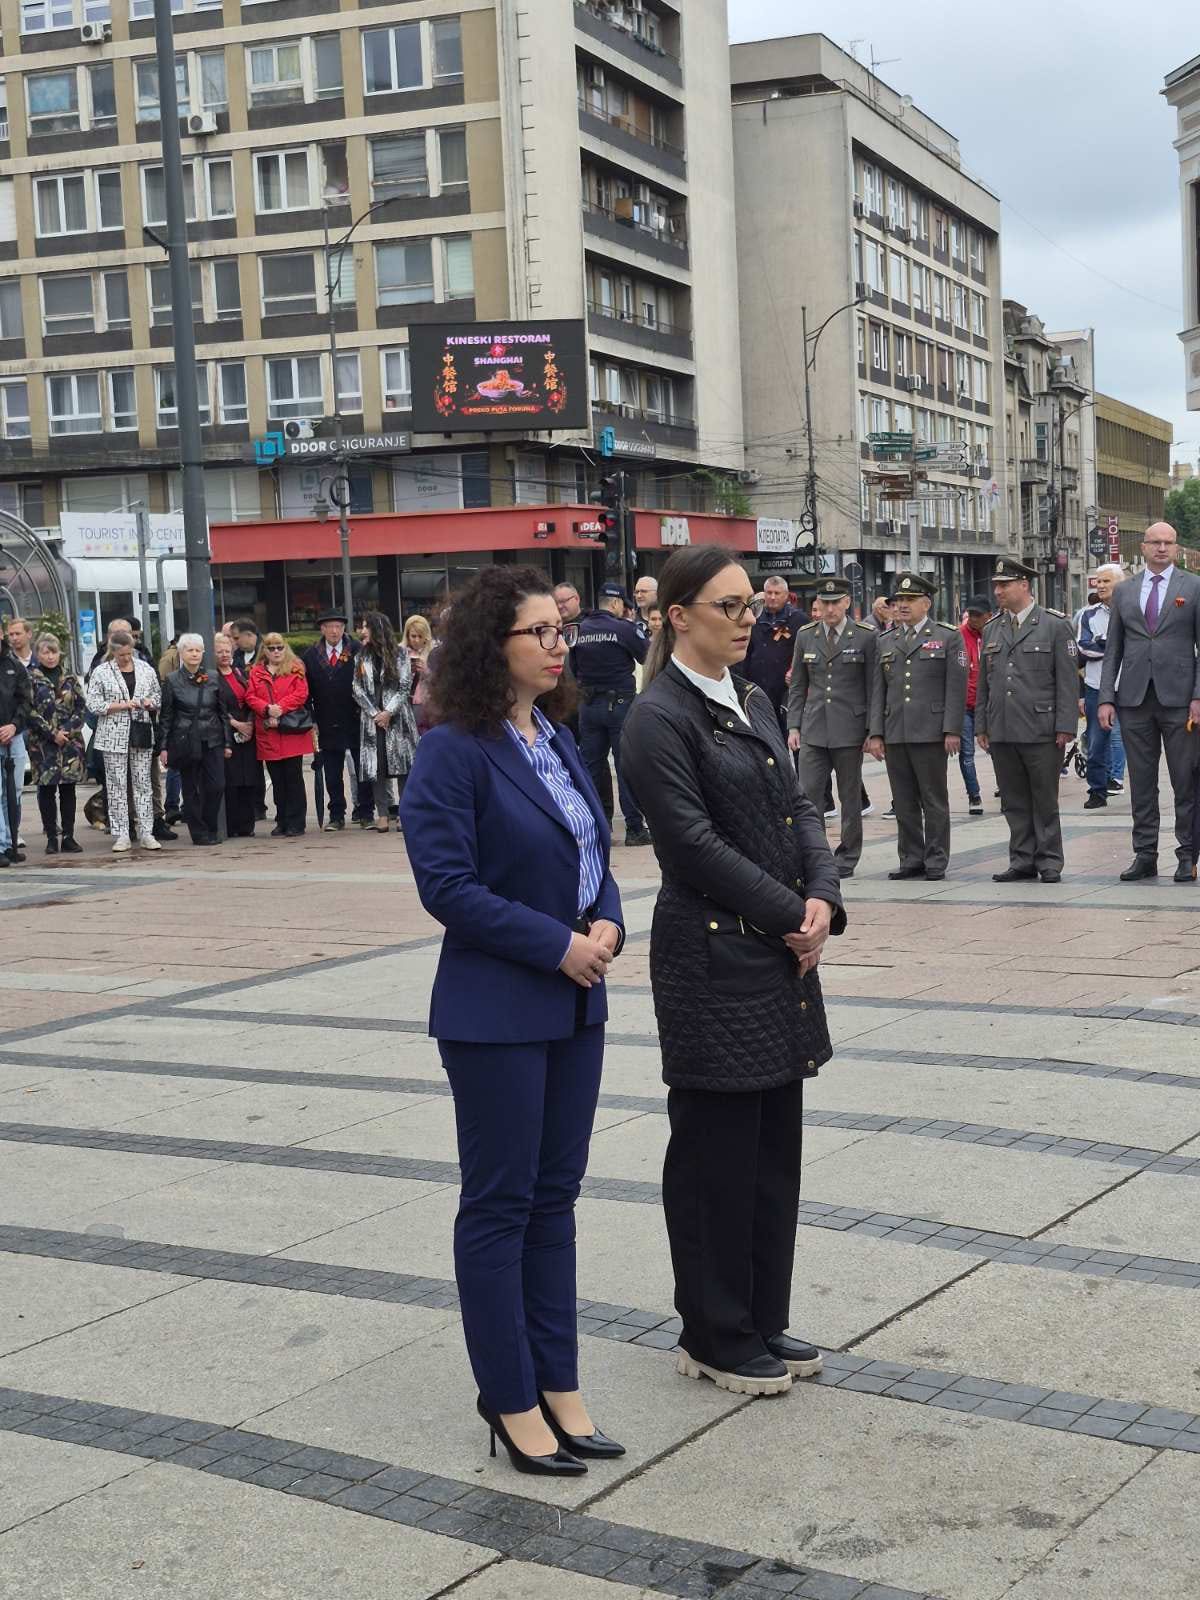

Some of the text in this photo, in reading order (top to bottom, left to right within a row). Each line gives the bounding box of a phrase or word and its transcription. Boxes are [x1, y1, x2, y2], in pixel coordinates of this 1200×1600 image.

[446, 334, 551, 345] KINESKI RESTORAN
[473, 356, 523, 365] SHANGHAI
[291, 441, 327, 454] DDOR
[78, 527, 126, 540] TOURIST
[758, 528, 790, 544] КЛЕОПАТРА
[1108, 515, 1120, 564] HOTEL
